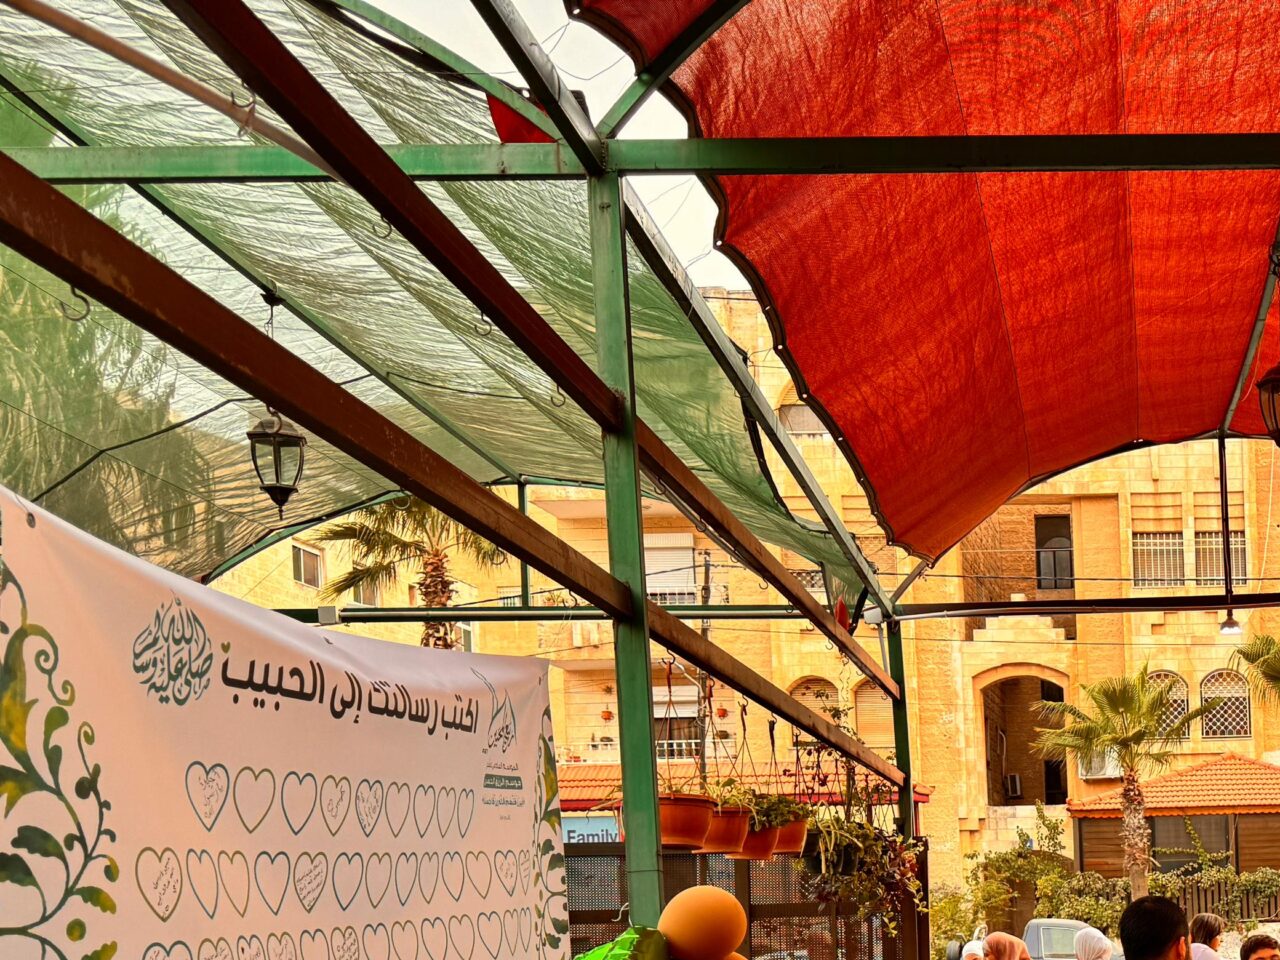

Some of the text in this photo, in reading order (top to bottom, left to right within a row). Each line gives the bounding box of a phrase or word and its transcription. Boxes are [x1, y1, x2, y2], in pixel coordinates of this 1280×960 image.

[220, 656, 480, 741] اكتب رسالتك إلى الحبيب
[566, 828, 618, 843] Family
